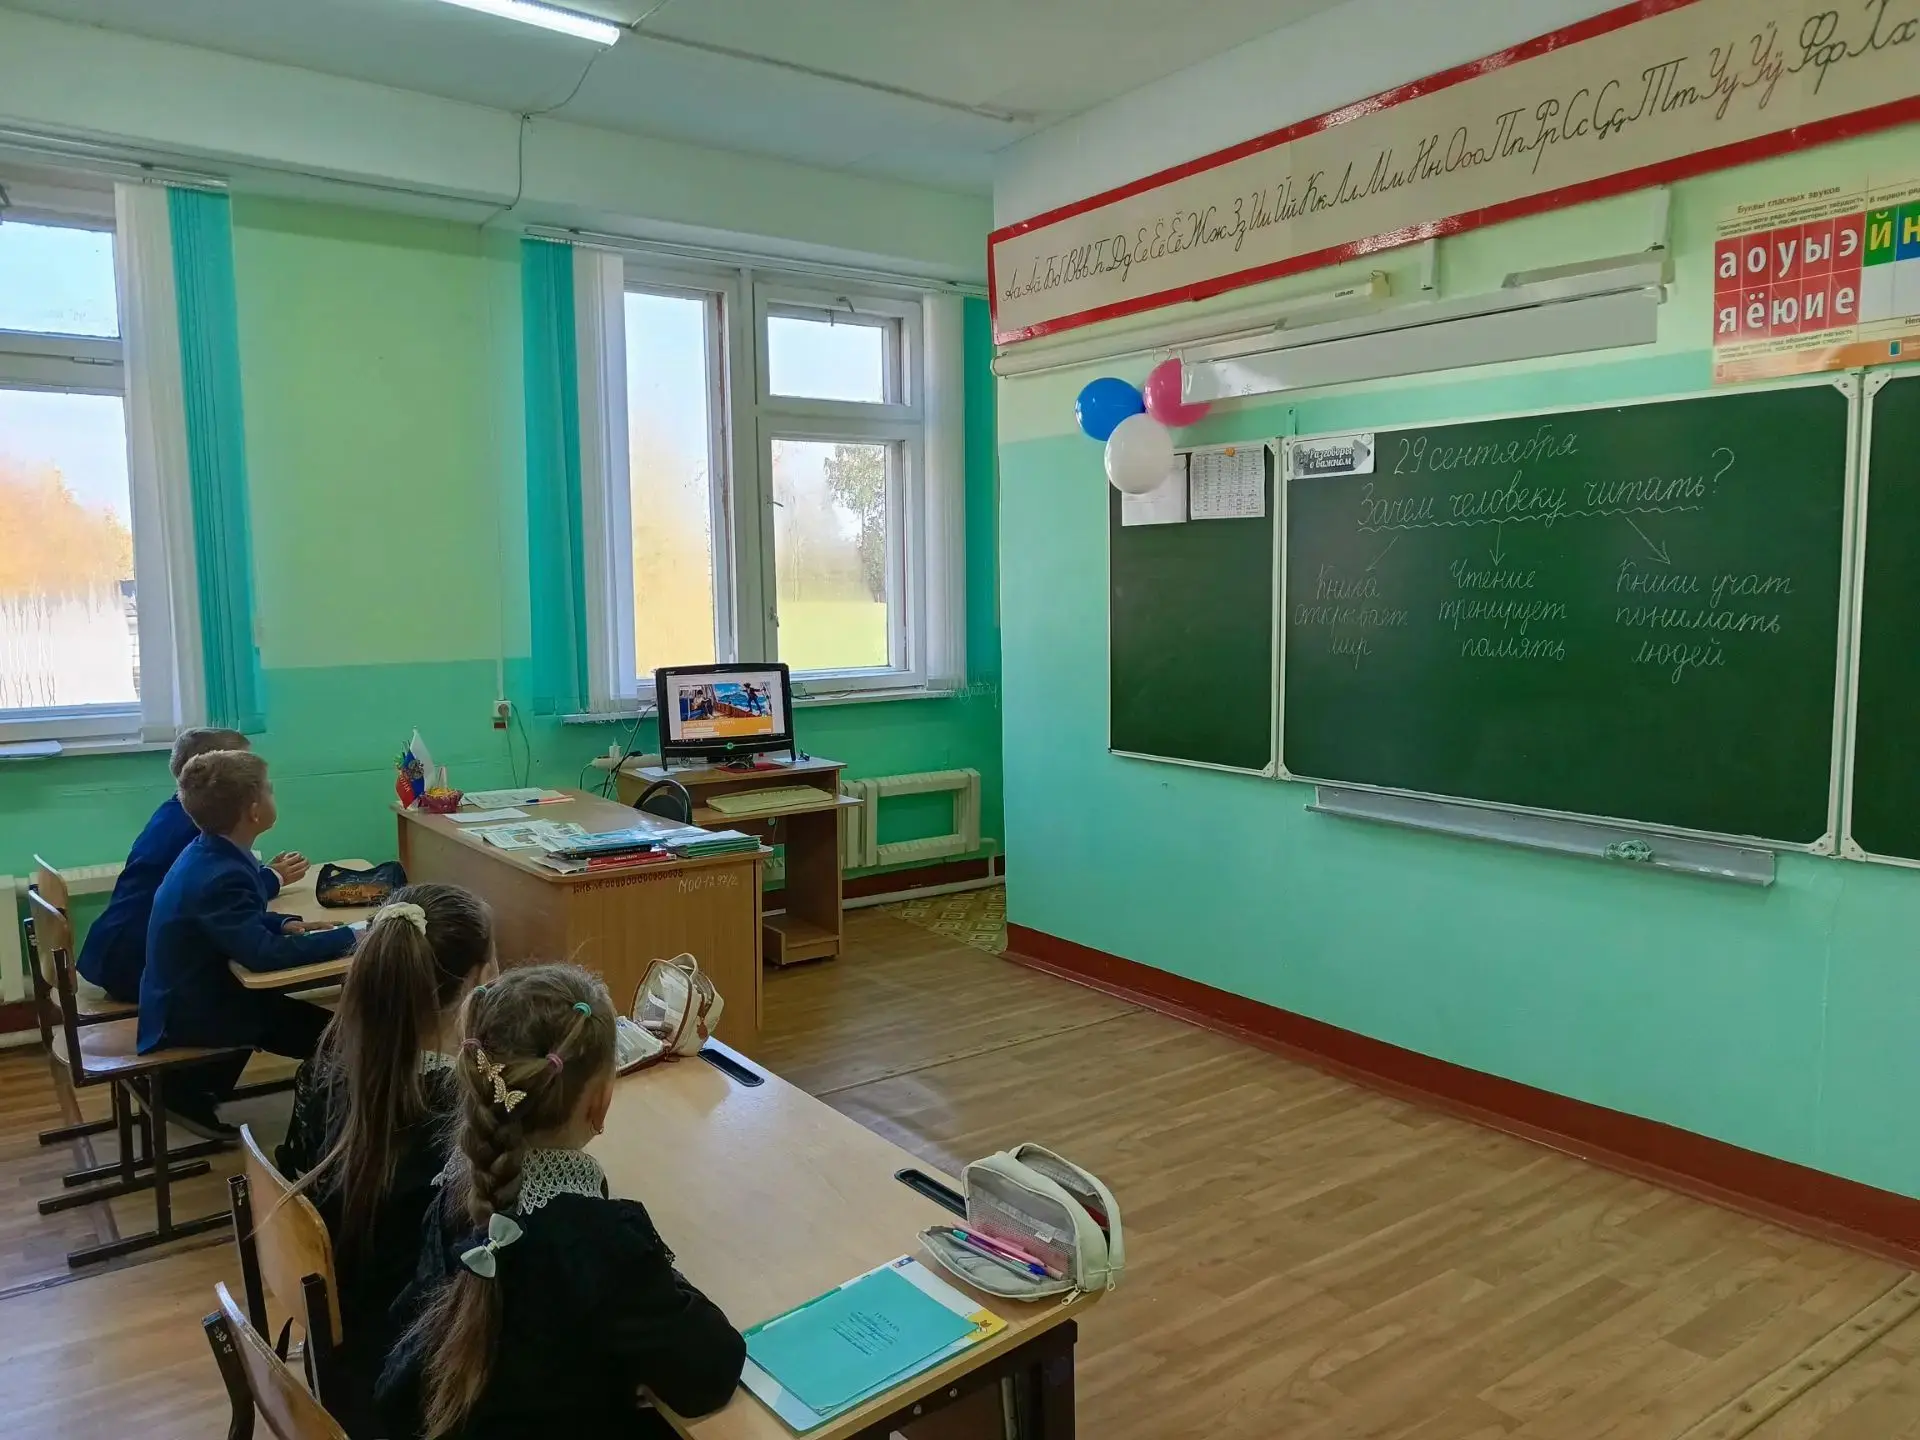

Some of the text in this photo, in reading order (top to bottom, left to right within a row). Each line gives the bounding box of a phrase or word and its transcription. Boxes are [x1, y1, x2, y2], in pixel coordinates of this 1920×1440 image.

[1737, 186, 1841, 214] Буквы гласных звуков
[1309, 445, 1352, 460] Разговоры
[1310, 457, 1352, 469] о важном
[1393, 424, 1579, 475] 29 сентября
[1357, 481, 1435, 525] Зачем
[1449, 469, 1567, 528] человеку
[1449, 558, 1537, 589] Чтение
[1616, 556, 1796, 609] Книги учат
[1438, 598, 1568, 636] тренирует
[1615, 606, 1781, 634] понимать
[1327, 637, 1372, 670] мир
[1461, 637, 1567, 661] память
[1631, 637, 1727, 684] людей
